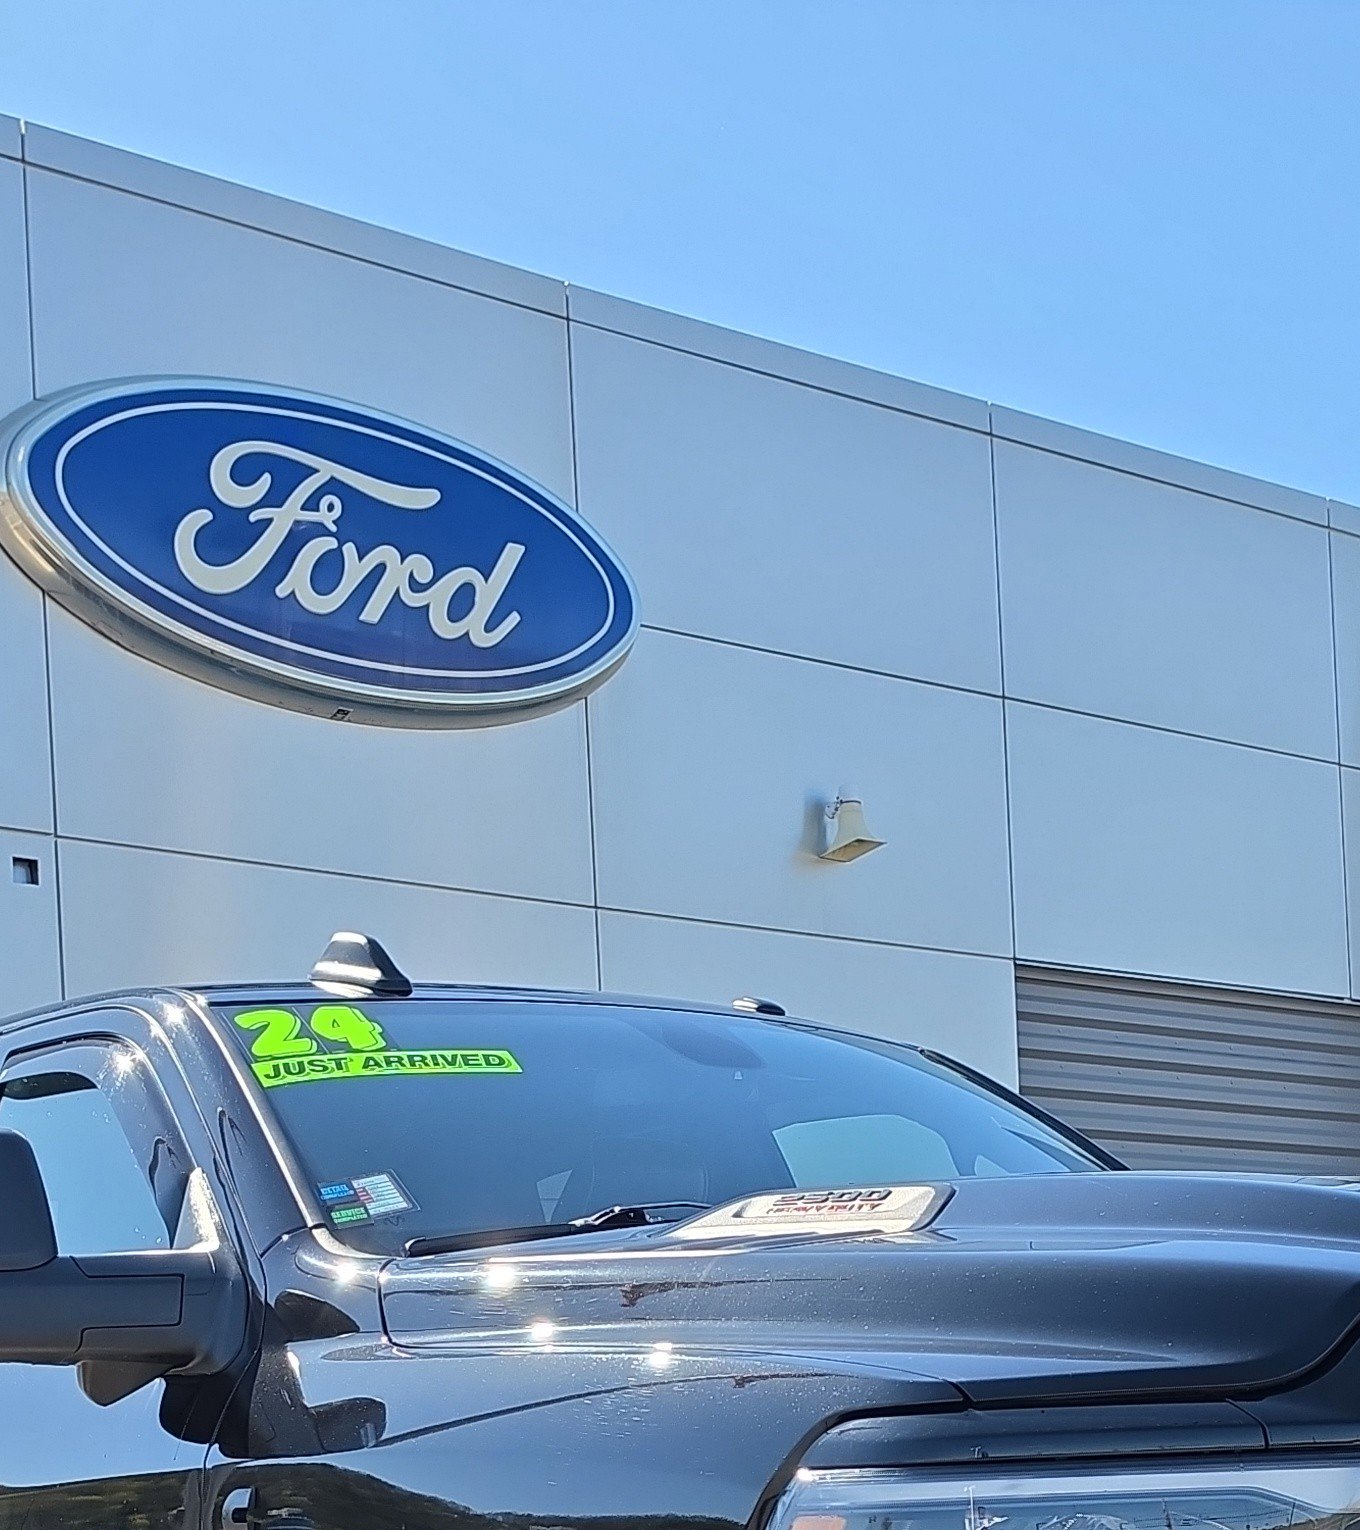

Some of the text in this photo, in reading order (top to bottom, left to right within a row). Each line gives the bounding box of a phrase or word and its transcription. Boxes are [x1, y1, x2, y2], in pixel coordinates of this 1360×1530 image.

[174, 440, 526, 649] Ford
[234, 1005, 387, 1058] 24
[264, 1053, 512, 1080] JUST ARRIVED
